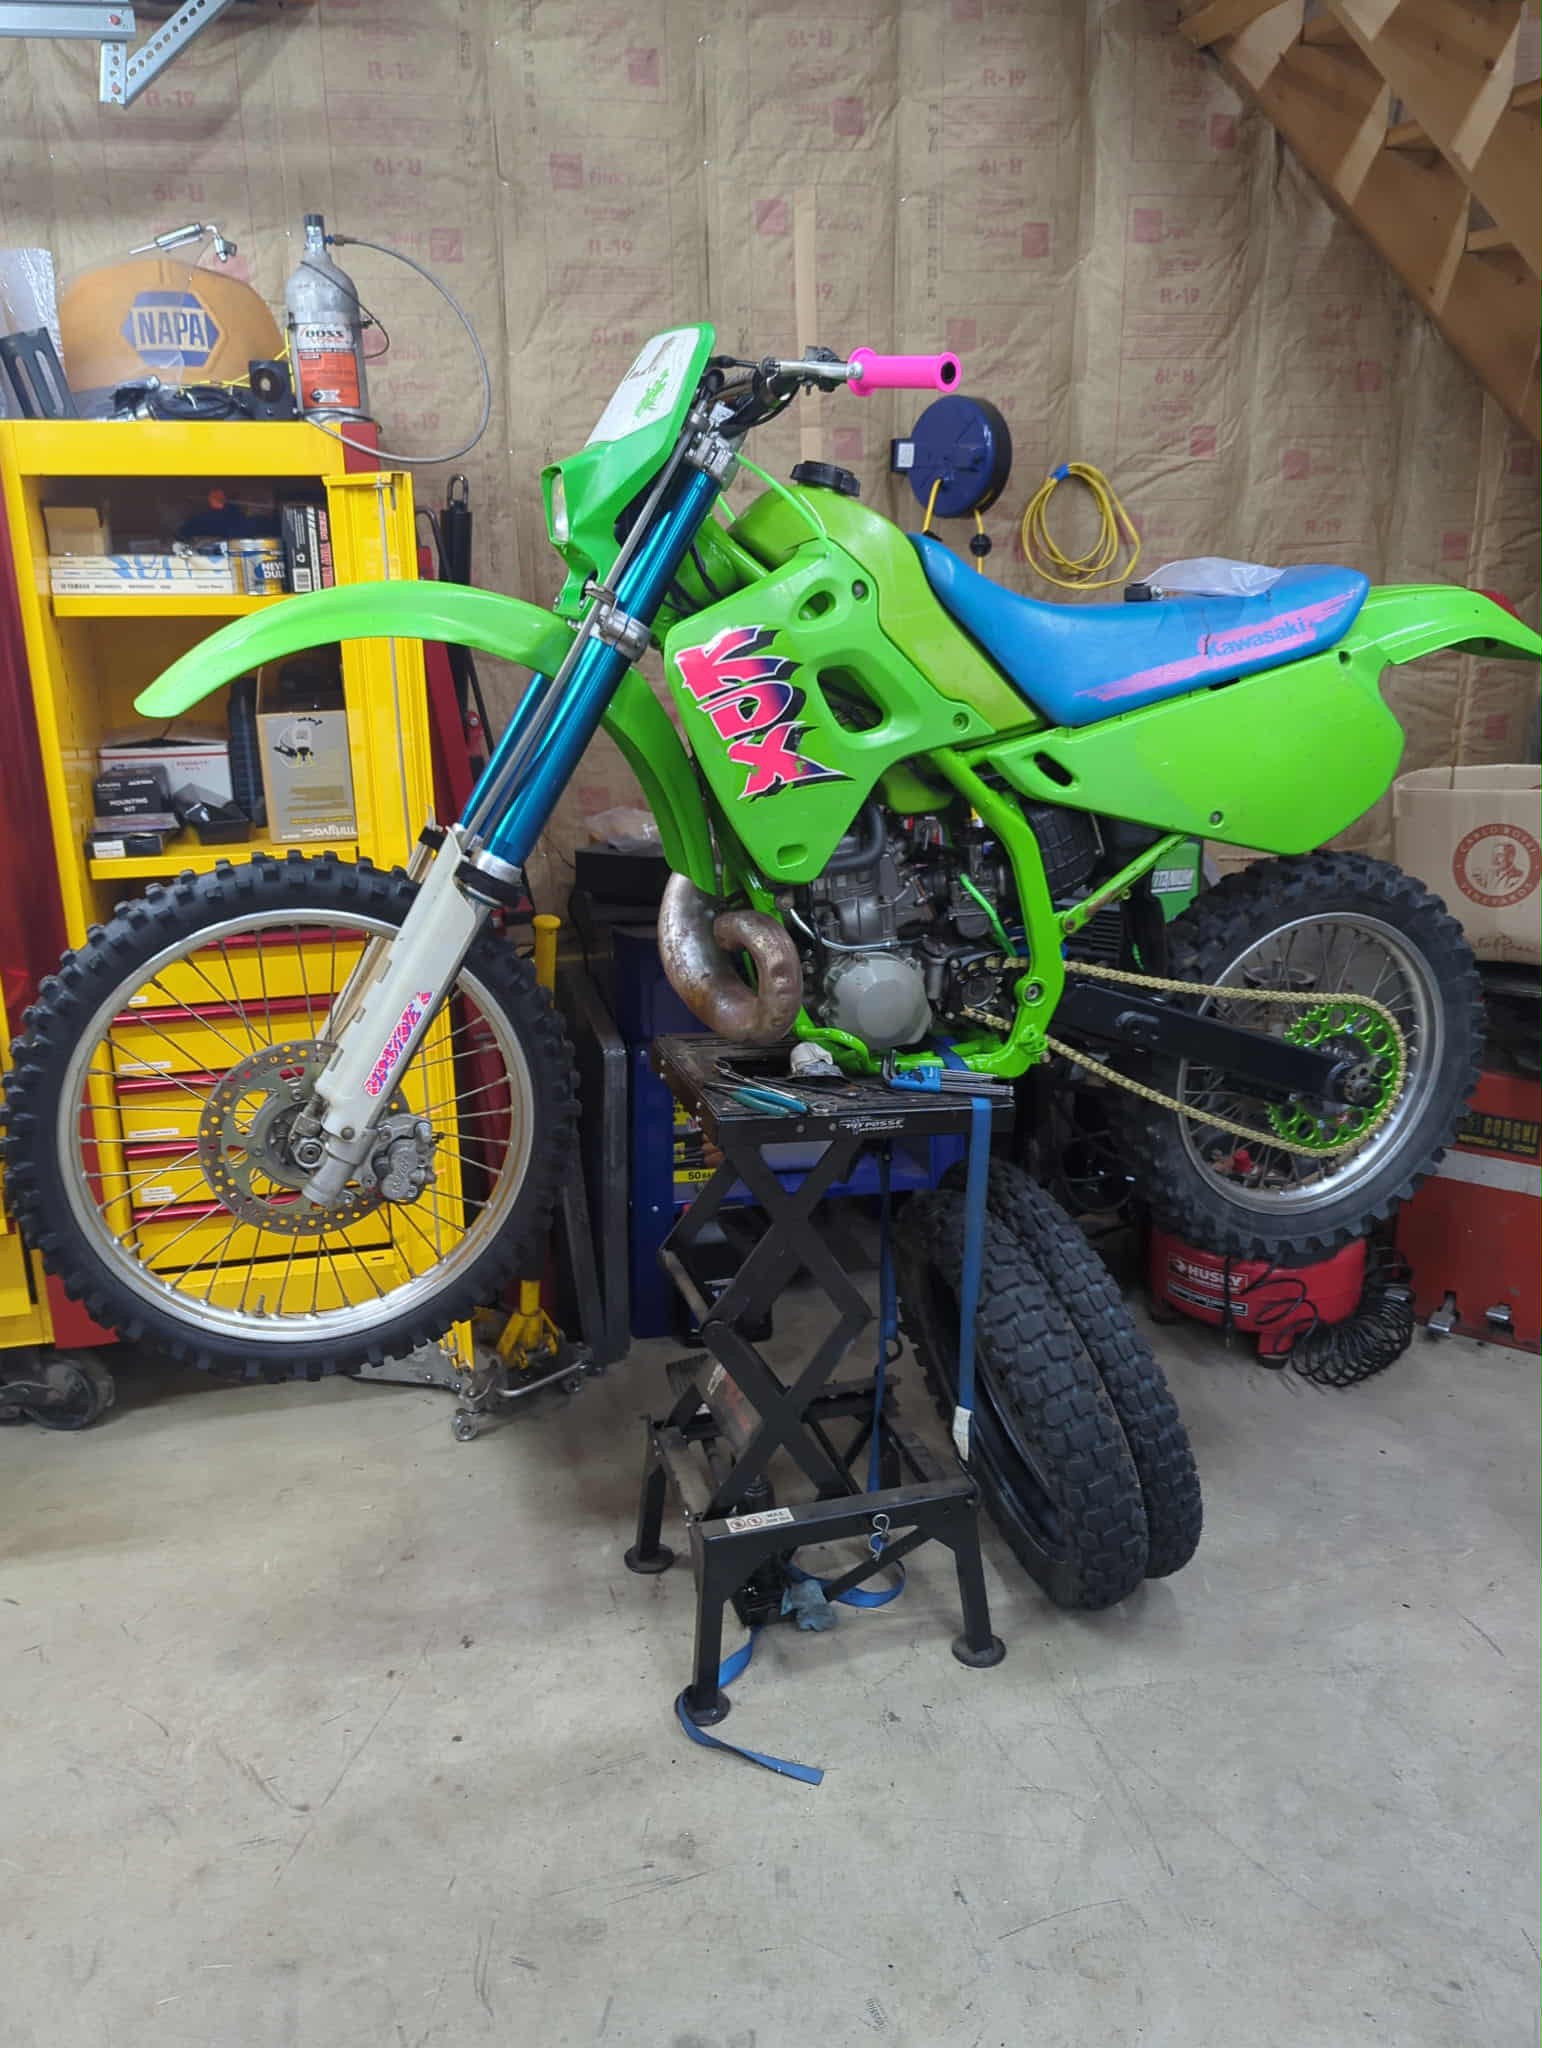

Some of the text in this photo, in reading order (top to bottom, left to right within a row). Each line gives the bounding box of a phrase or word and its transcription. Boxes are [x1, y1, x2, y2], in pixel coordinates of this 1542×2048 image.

[137, 311, 207, 346] NAPA
[1206, 616, 1307, 661] Kawasaki
[674, 624, 857, 803] KDX
[688, 1171, 701, 1180] 50
